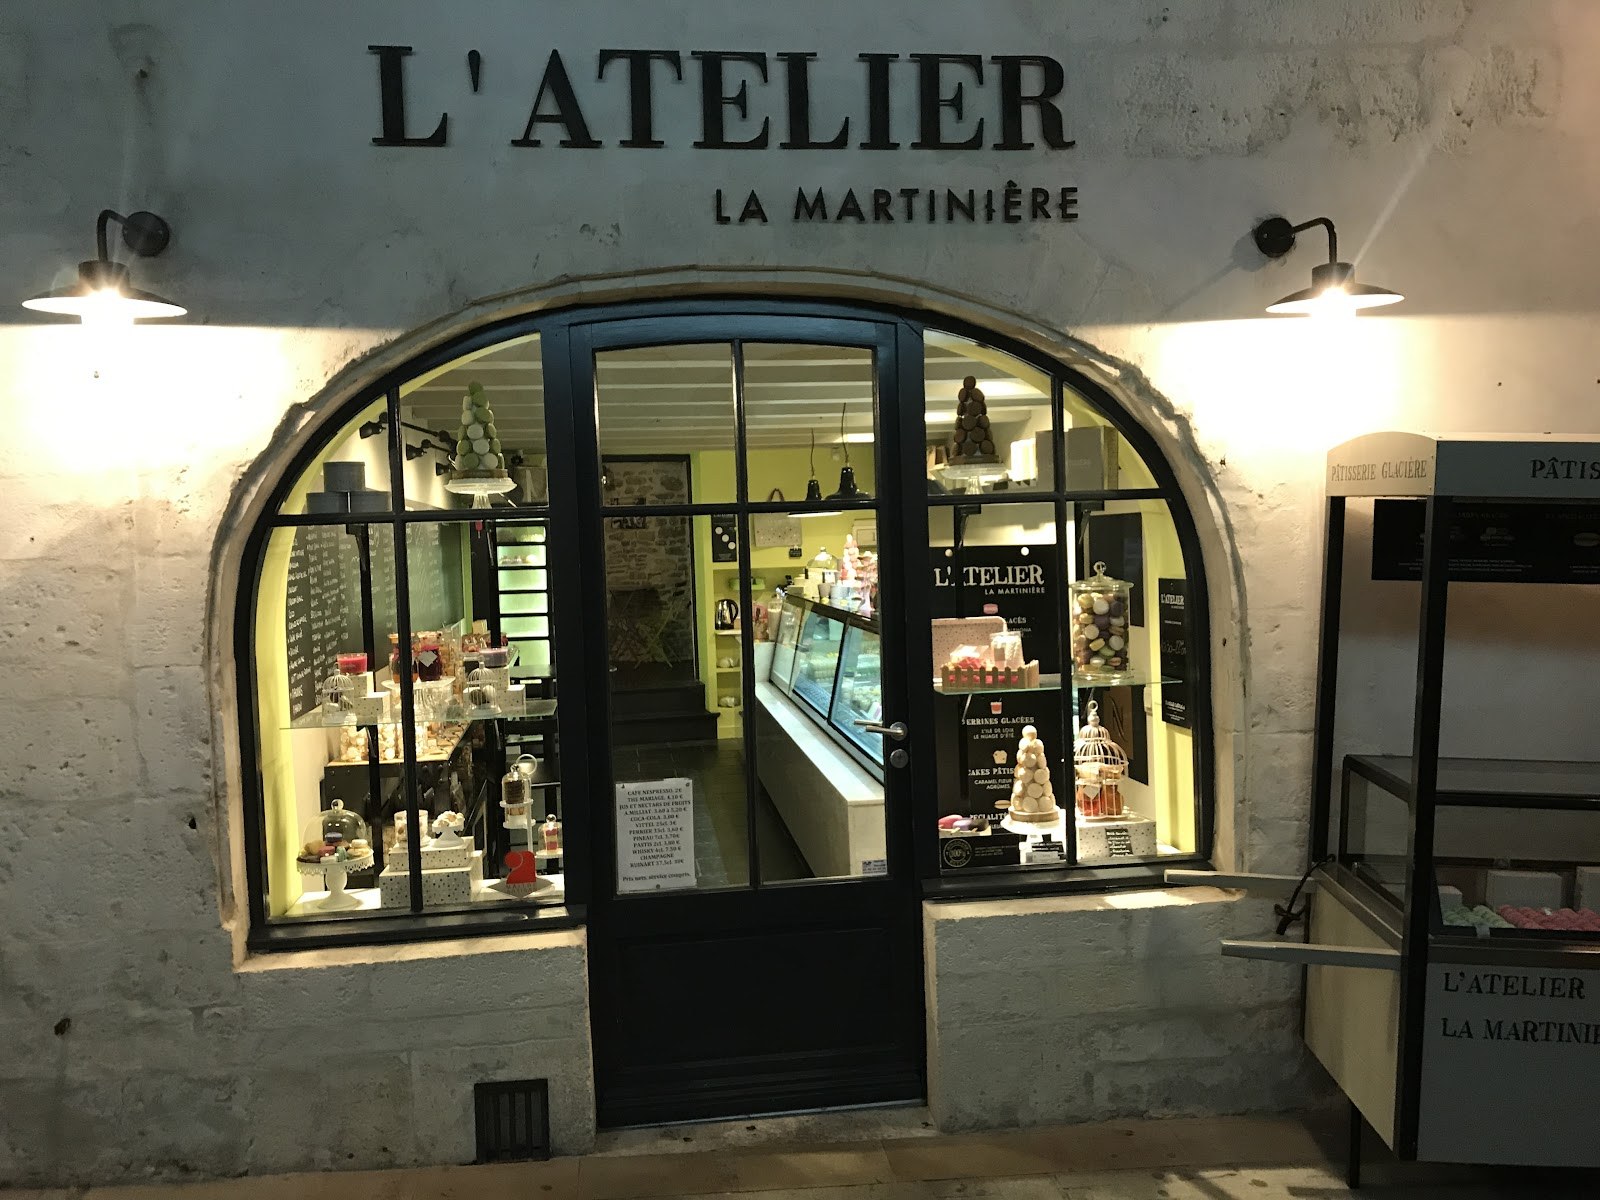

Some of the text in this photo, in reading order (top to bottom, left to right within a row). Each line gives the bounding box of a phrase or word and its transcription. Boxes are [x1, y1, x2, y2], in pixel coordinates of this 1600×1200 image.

[367, 45, 1076, 150] L'ATELIER
[714, 190, 768, 222] LA
[1331, 463, 1376, 481] PÂTISSERIE
[1530, 456, 1600, 480] PÂTIS
[933, 564, 1044, 586] L'TELIER
[1443, 971, 1585, 999] L'ATELIER
[1441, 1017, 1474, 1039] LA
